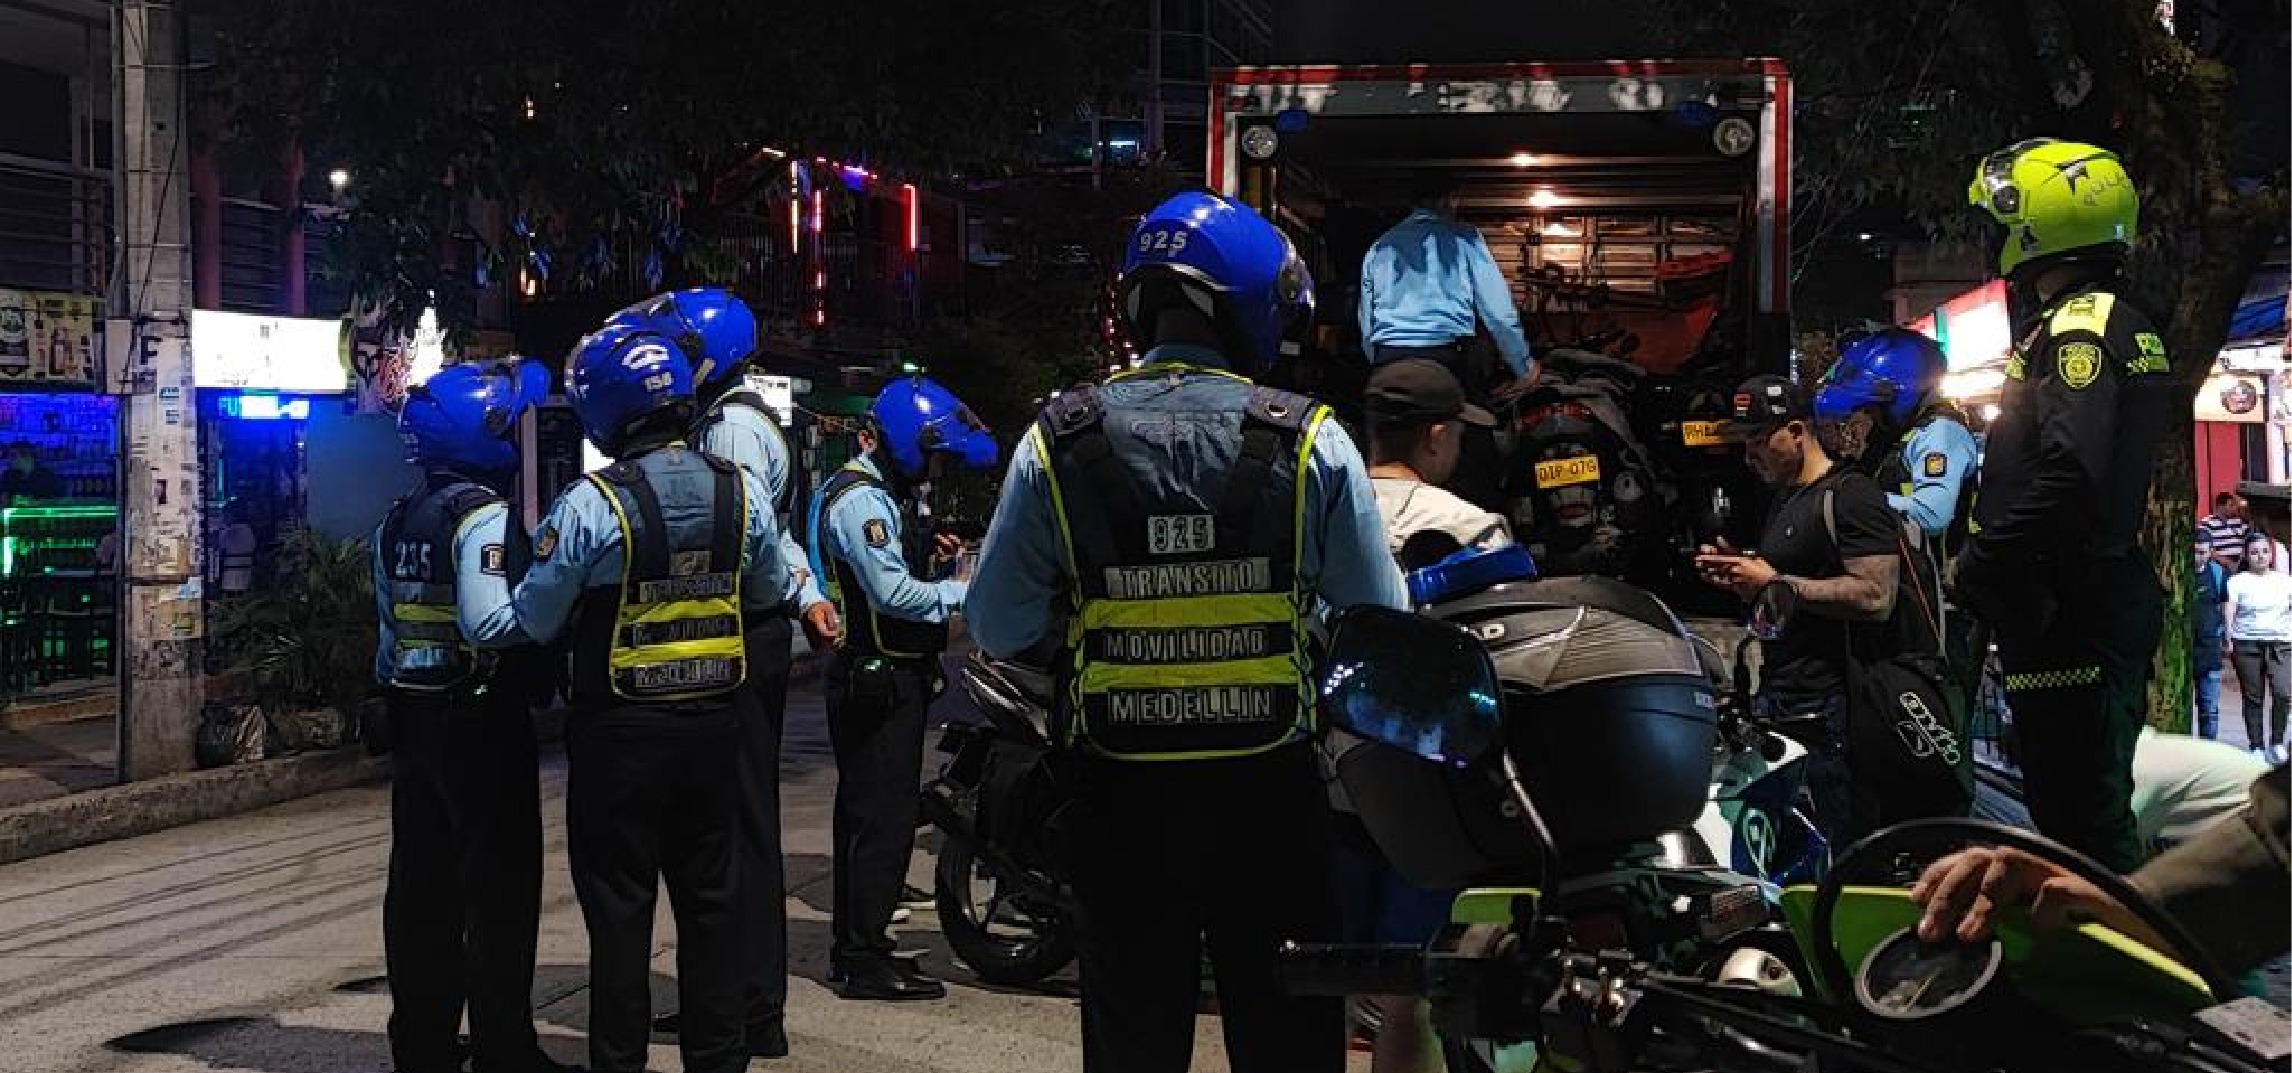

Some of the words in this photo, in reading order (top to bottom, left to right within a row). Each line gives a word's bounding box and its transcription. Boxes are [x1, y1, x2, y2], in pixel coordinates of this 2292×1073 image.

[1139, 231, 1187, 252] 925
[1153, 517, 1208, 551] 925
[1111, 689, 1271, 722] MEDELLIN
